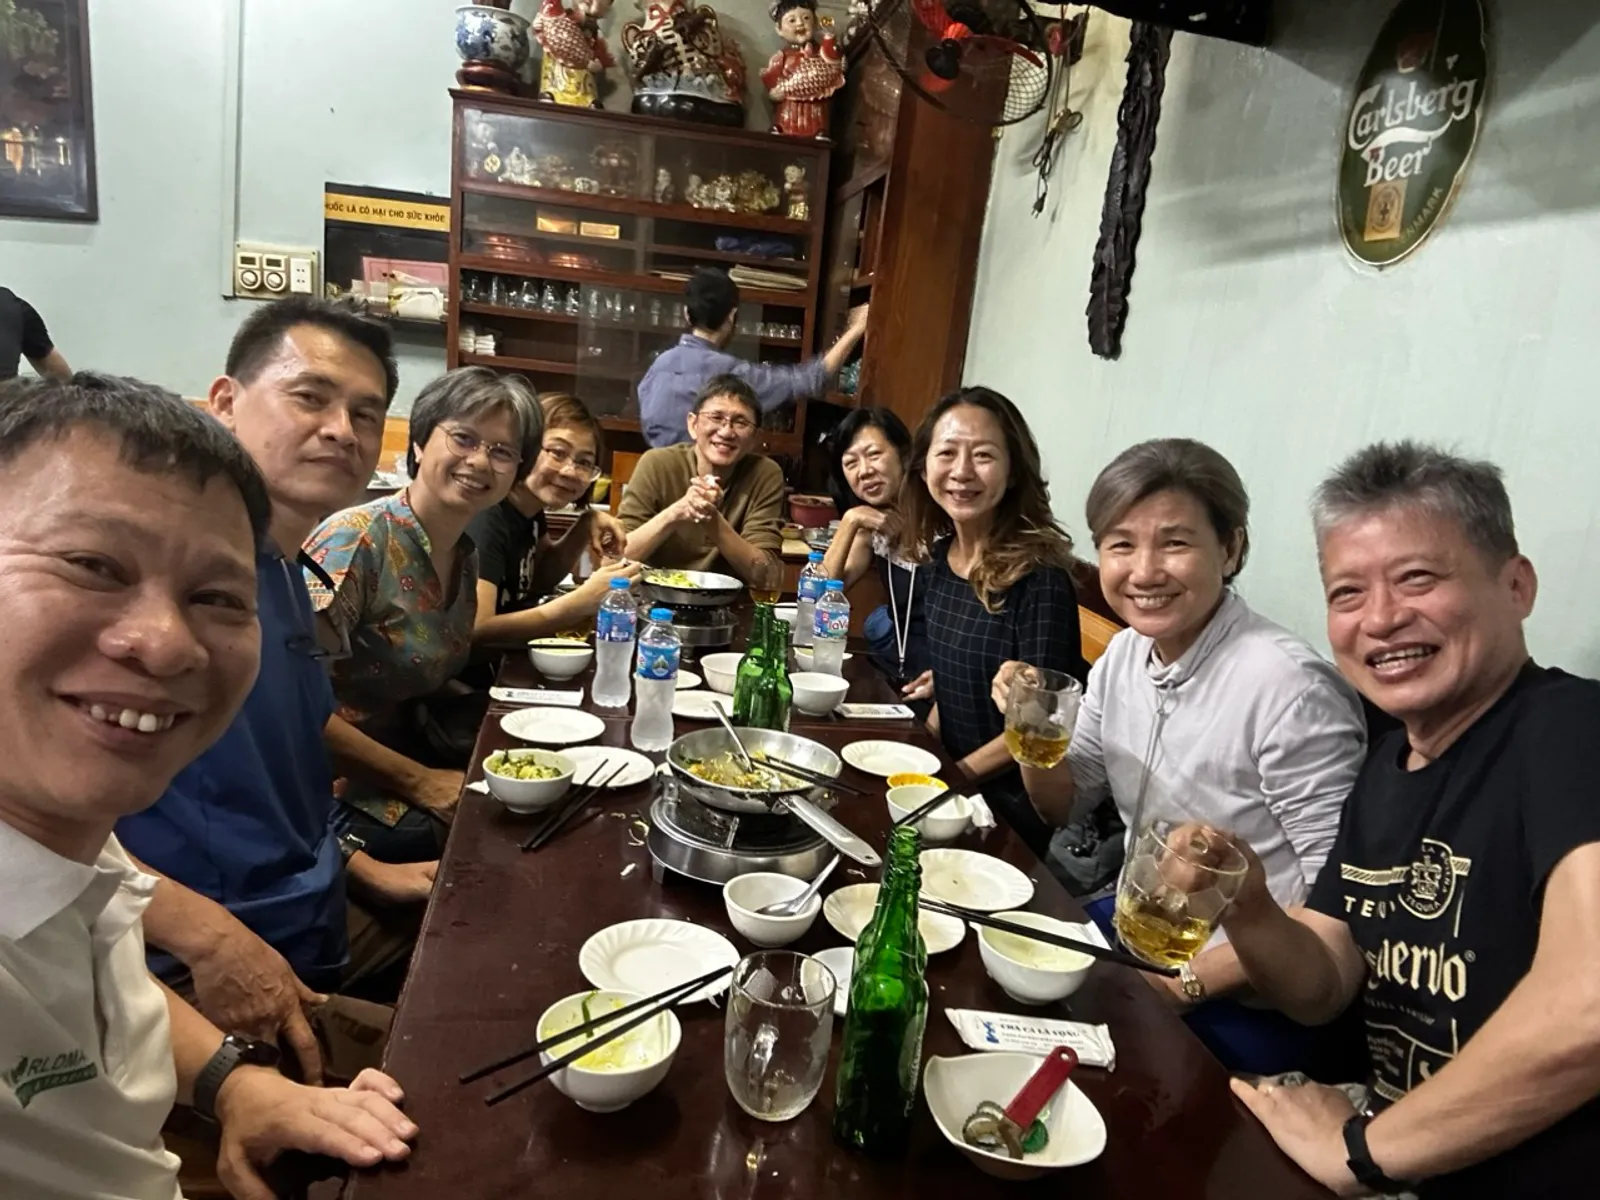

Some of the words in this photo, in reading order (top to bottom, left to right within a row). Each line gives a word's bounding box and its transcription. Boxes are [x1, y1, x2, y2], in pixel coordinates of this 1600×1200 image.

[1348, 77, 1478, 151] Carlsberg
[1363, 140, 1433, 188] Beer
[388, 209, 404, 219] CHO
